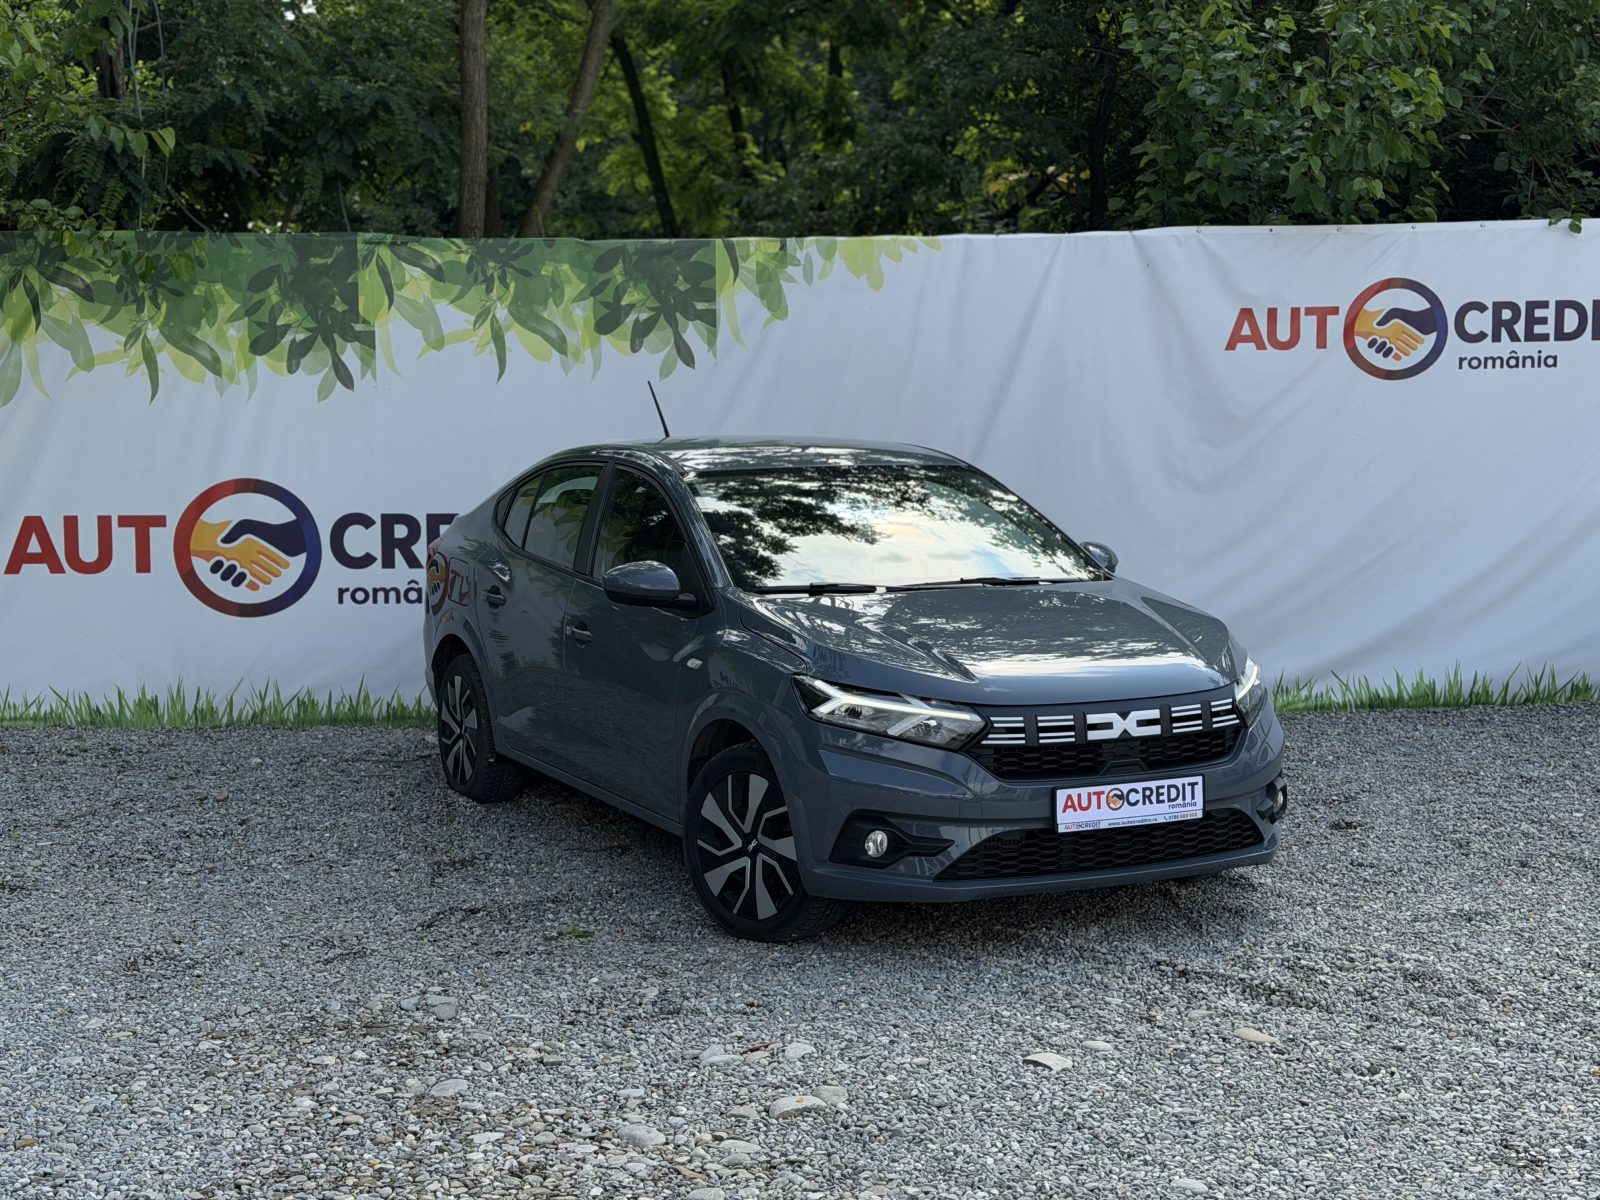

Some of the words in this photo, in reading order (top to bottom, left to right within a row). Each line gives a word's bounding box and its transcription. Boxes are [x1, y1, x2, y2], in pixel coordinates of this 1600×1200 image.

[1458, 351, 1558, 370] românia
[338, 579, 423, 605] româ
[1168, 800, 1198, 810] românia
